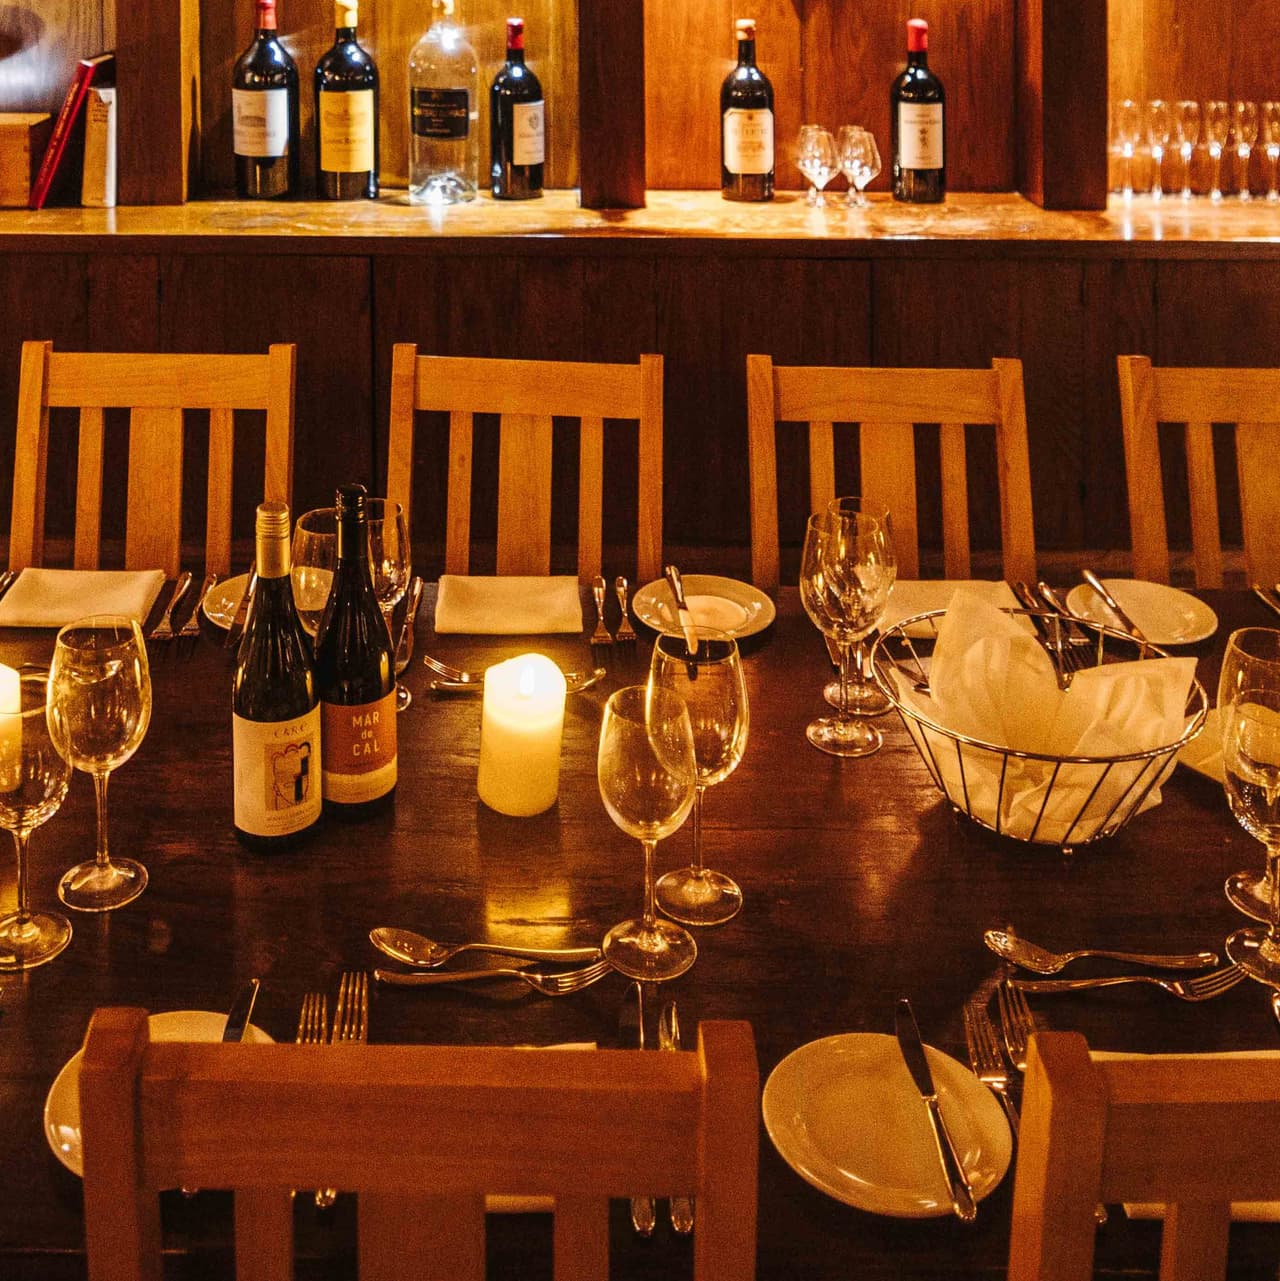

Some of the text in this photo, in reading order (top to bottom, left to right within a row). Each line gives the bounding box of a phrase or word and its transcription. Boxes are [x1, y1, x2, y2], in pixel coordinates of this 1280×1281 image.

[352, 711, 380, 728] MAR
[361, 729, 374, 740] de
[352, 738, 380, 757] CAL
